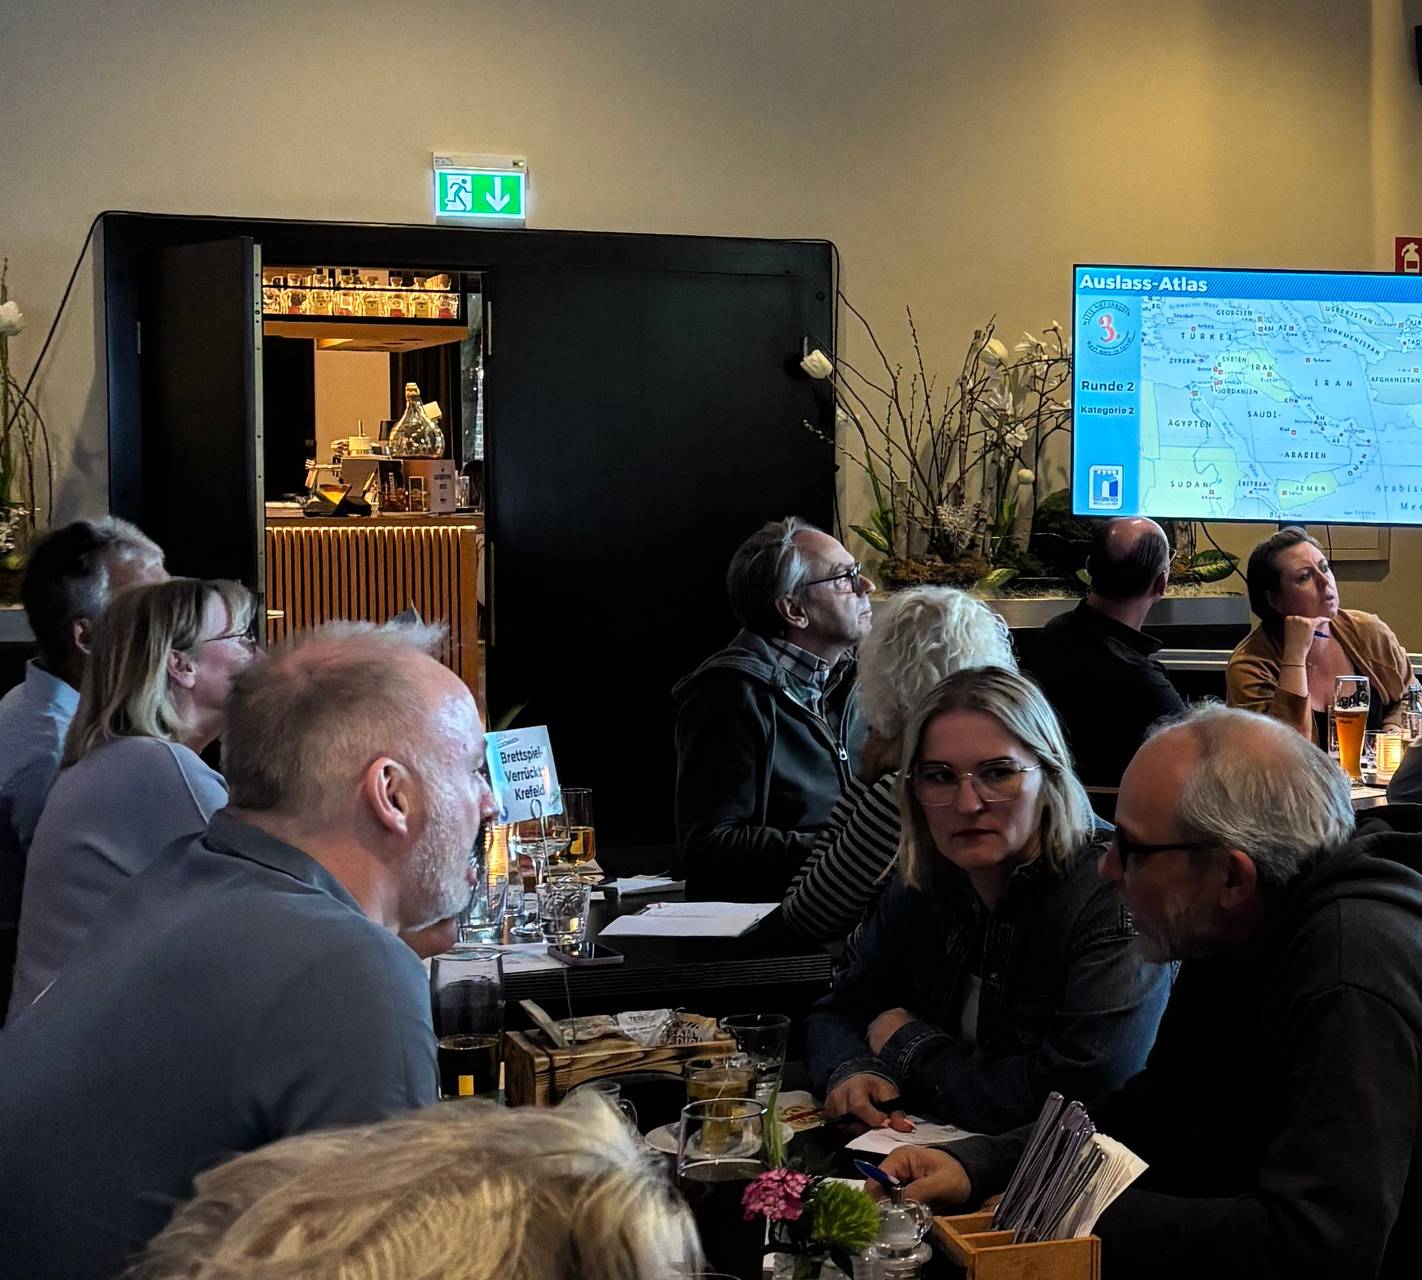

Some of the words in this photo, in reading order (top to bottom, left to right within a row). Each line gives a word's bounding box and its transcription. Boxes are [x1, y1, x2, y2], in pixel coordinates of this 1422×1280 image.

[1079, 274, 1208, 292] Auslass-Atlas
[1081, 381, 1124, 392] Runde
[1126, 382, 1134, 392] 2
[1129, 407, 1135, 415] 2
[500, 745, 543, 765] Brettspiel-
[504, 766, 546, 783] Verrückt
[514, 784, 546, 801] Krefeld
